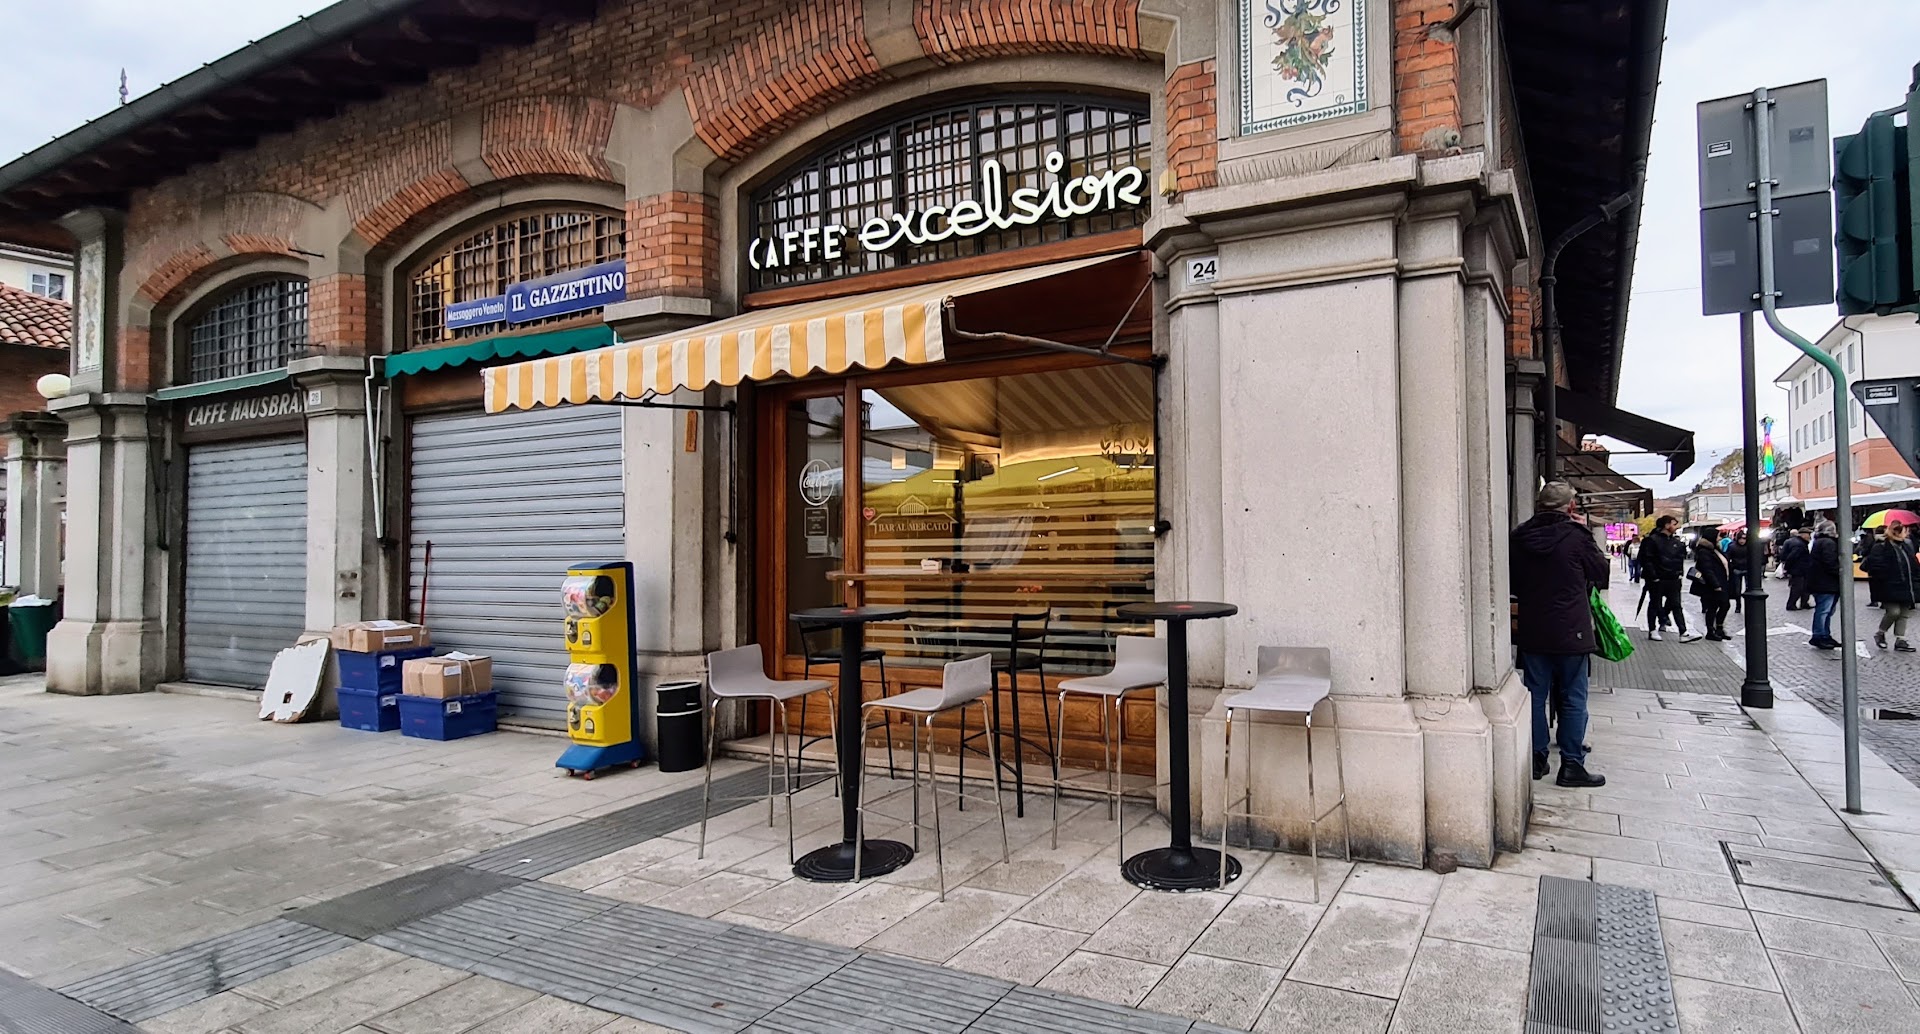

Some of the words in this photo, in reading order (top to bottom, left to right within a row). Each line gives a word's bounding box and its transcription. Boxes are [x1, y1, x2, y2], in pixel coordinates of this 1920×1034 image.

[1193, 260, 1217, 279] 24
[511, 293, 526, 313] IL
[529, 271, 625, 308] GAZZETTINO
[482, 302, 504, 316] Veneto
[188, 402, 227, 426] CAFFE
[879, 523, 895, 532] BAR
[896, 523, 908, 532] AL
[908, 522, 949, 532] MERCATO
